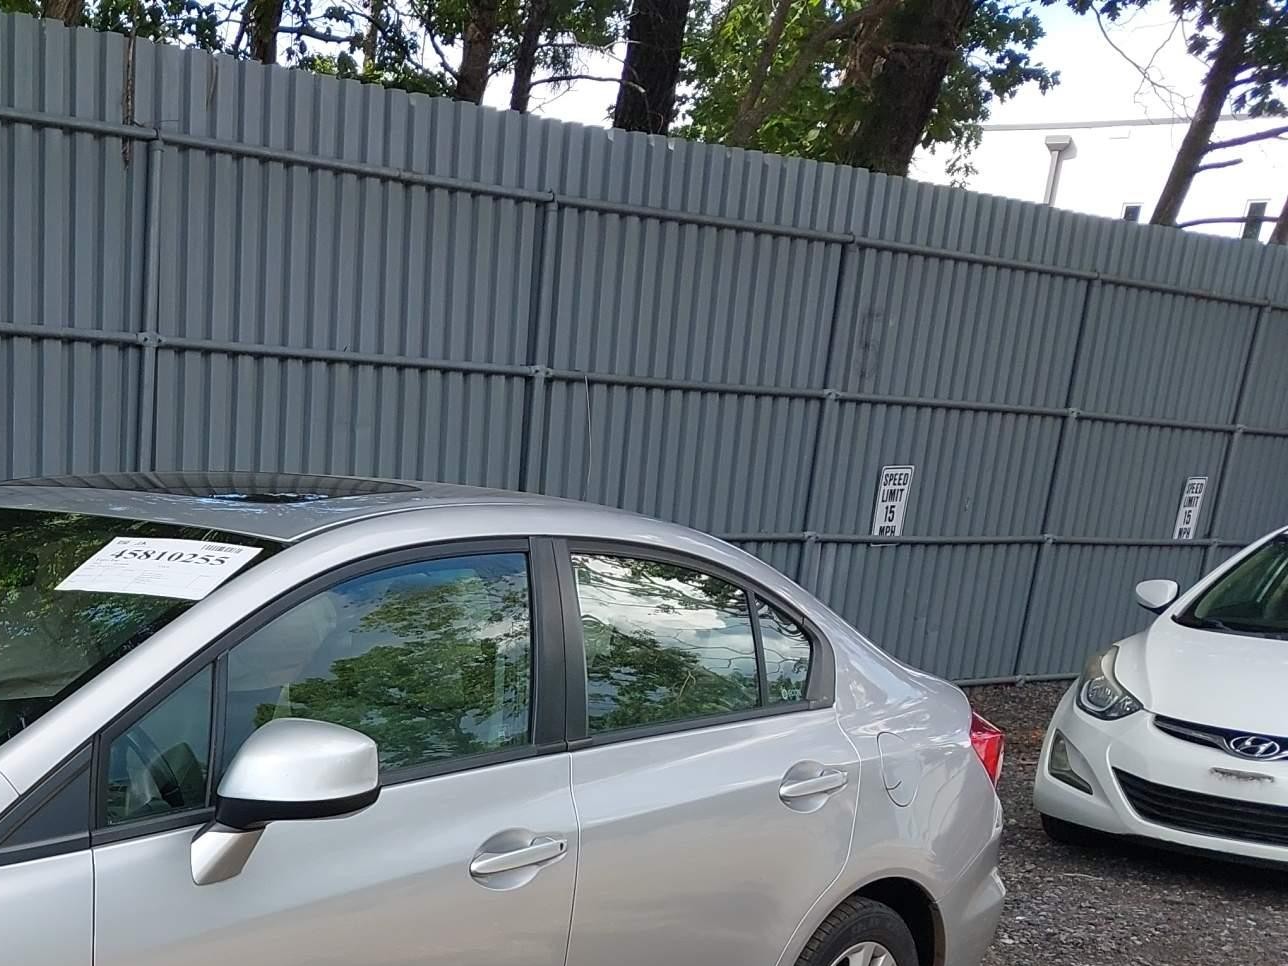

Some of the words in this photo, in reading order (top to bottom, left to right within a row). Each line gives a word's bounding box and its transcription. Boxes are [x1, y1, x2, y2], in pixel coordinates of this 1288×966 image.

[883, 472, 909, 486] SPEED
[881, 488, 904, 502] LIMIT
[1186, 482, 1204, 494] SPEED
[1183, 496, 1199, 508] LIMIT
[884, 505, 896, 523] 15
[1183, 510, 1192, 525] 15
[879, 525, 896, 536] MPH
[110, 548, 232, 566] 45810255
